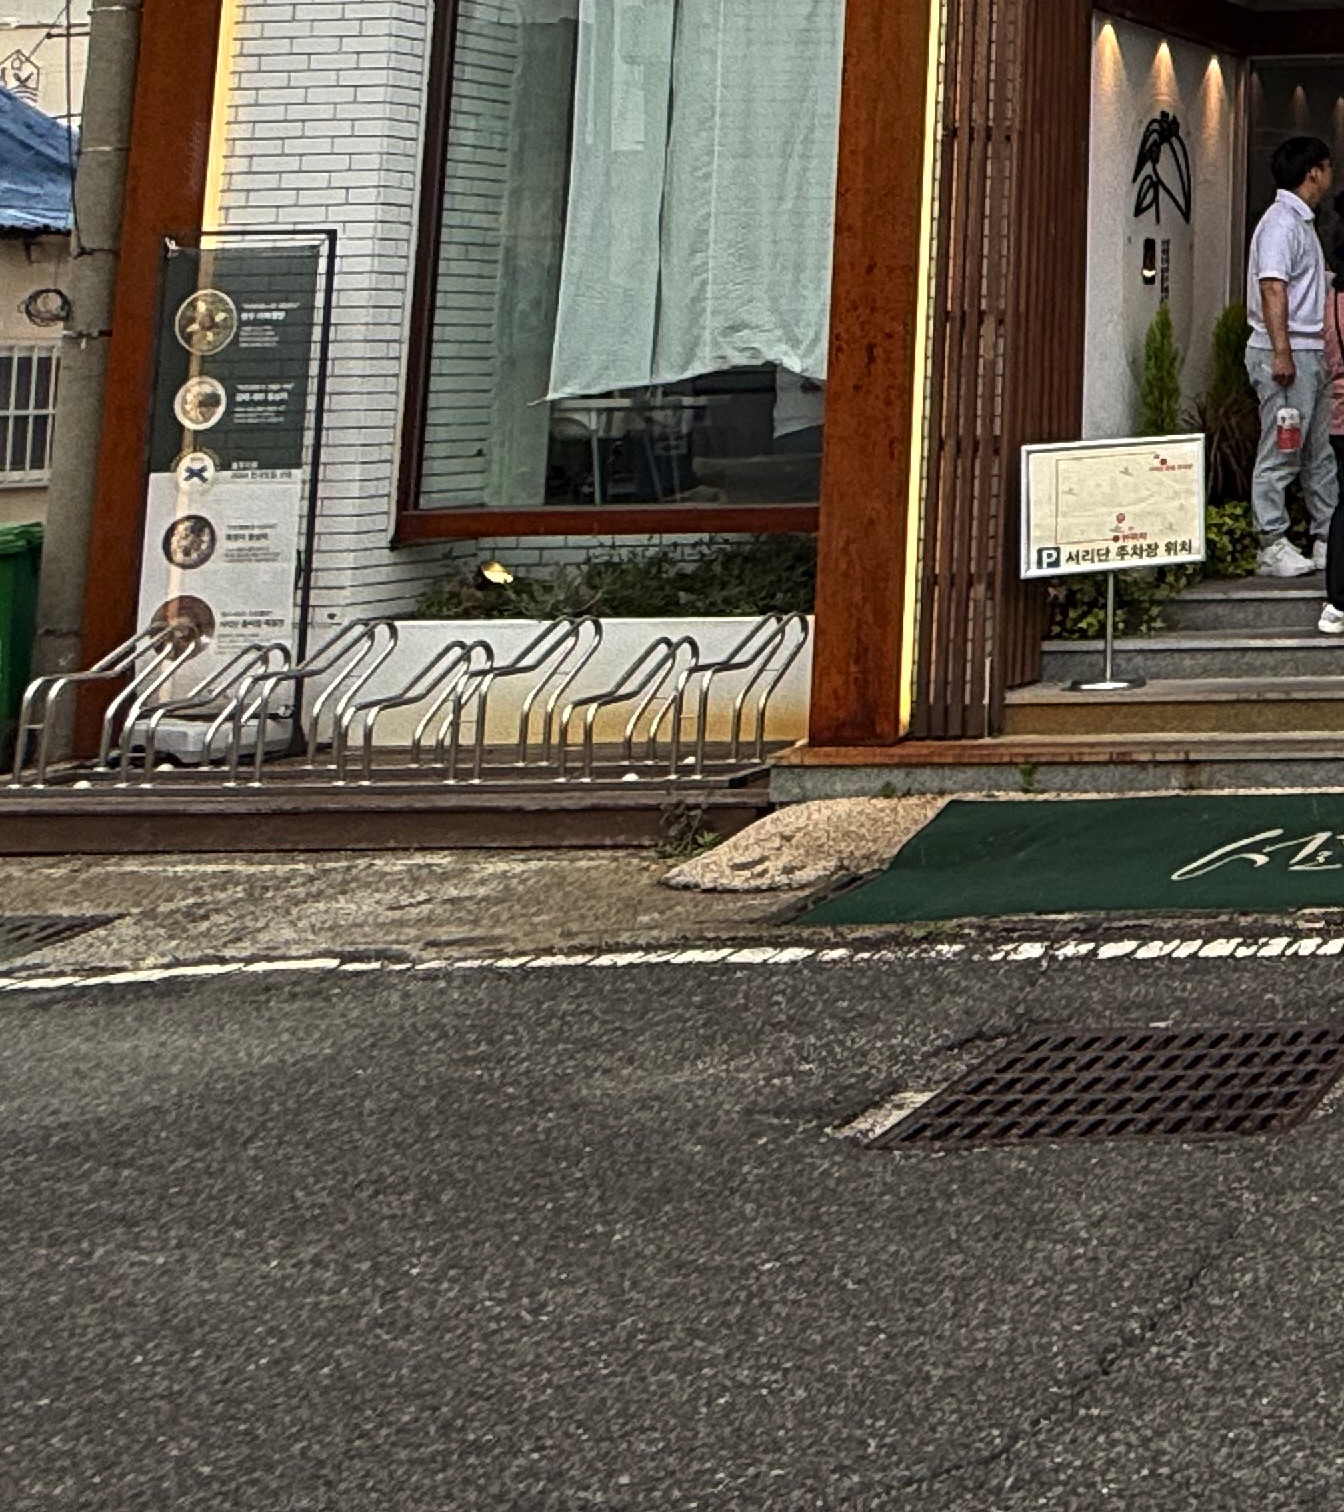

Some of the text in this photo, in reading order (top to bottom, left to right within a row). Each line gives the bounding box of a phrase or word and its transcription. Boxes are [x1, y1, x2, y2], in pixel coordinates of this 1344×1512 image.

[1065, 544, 1111, 565] 서리단
[1115, 541, 1160, 561] 주차장
[1164, 539, 1193, 555] 위치
